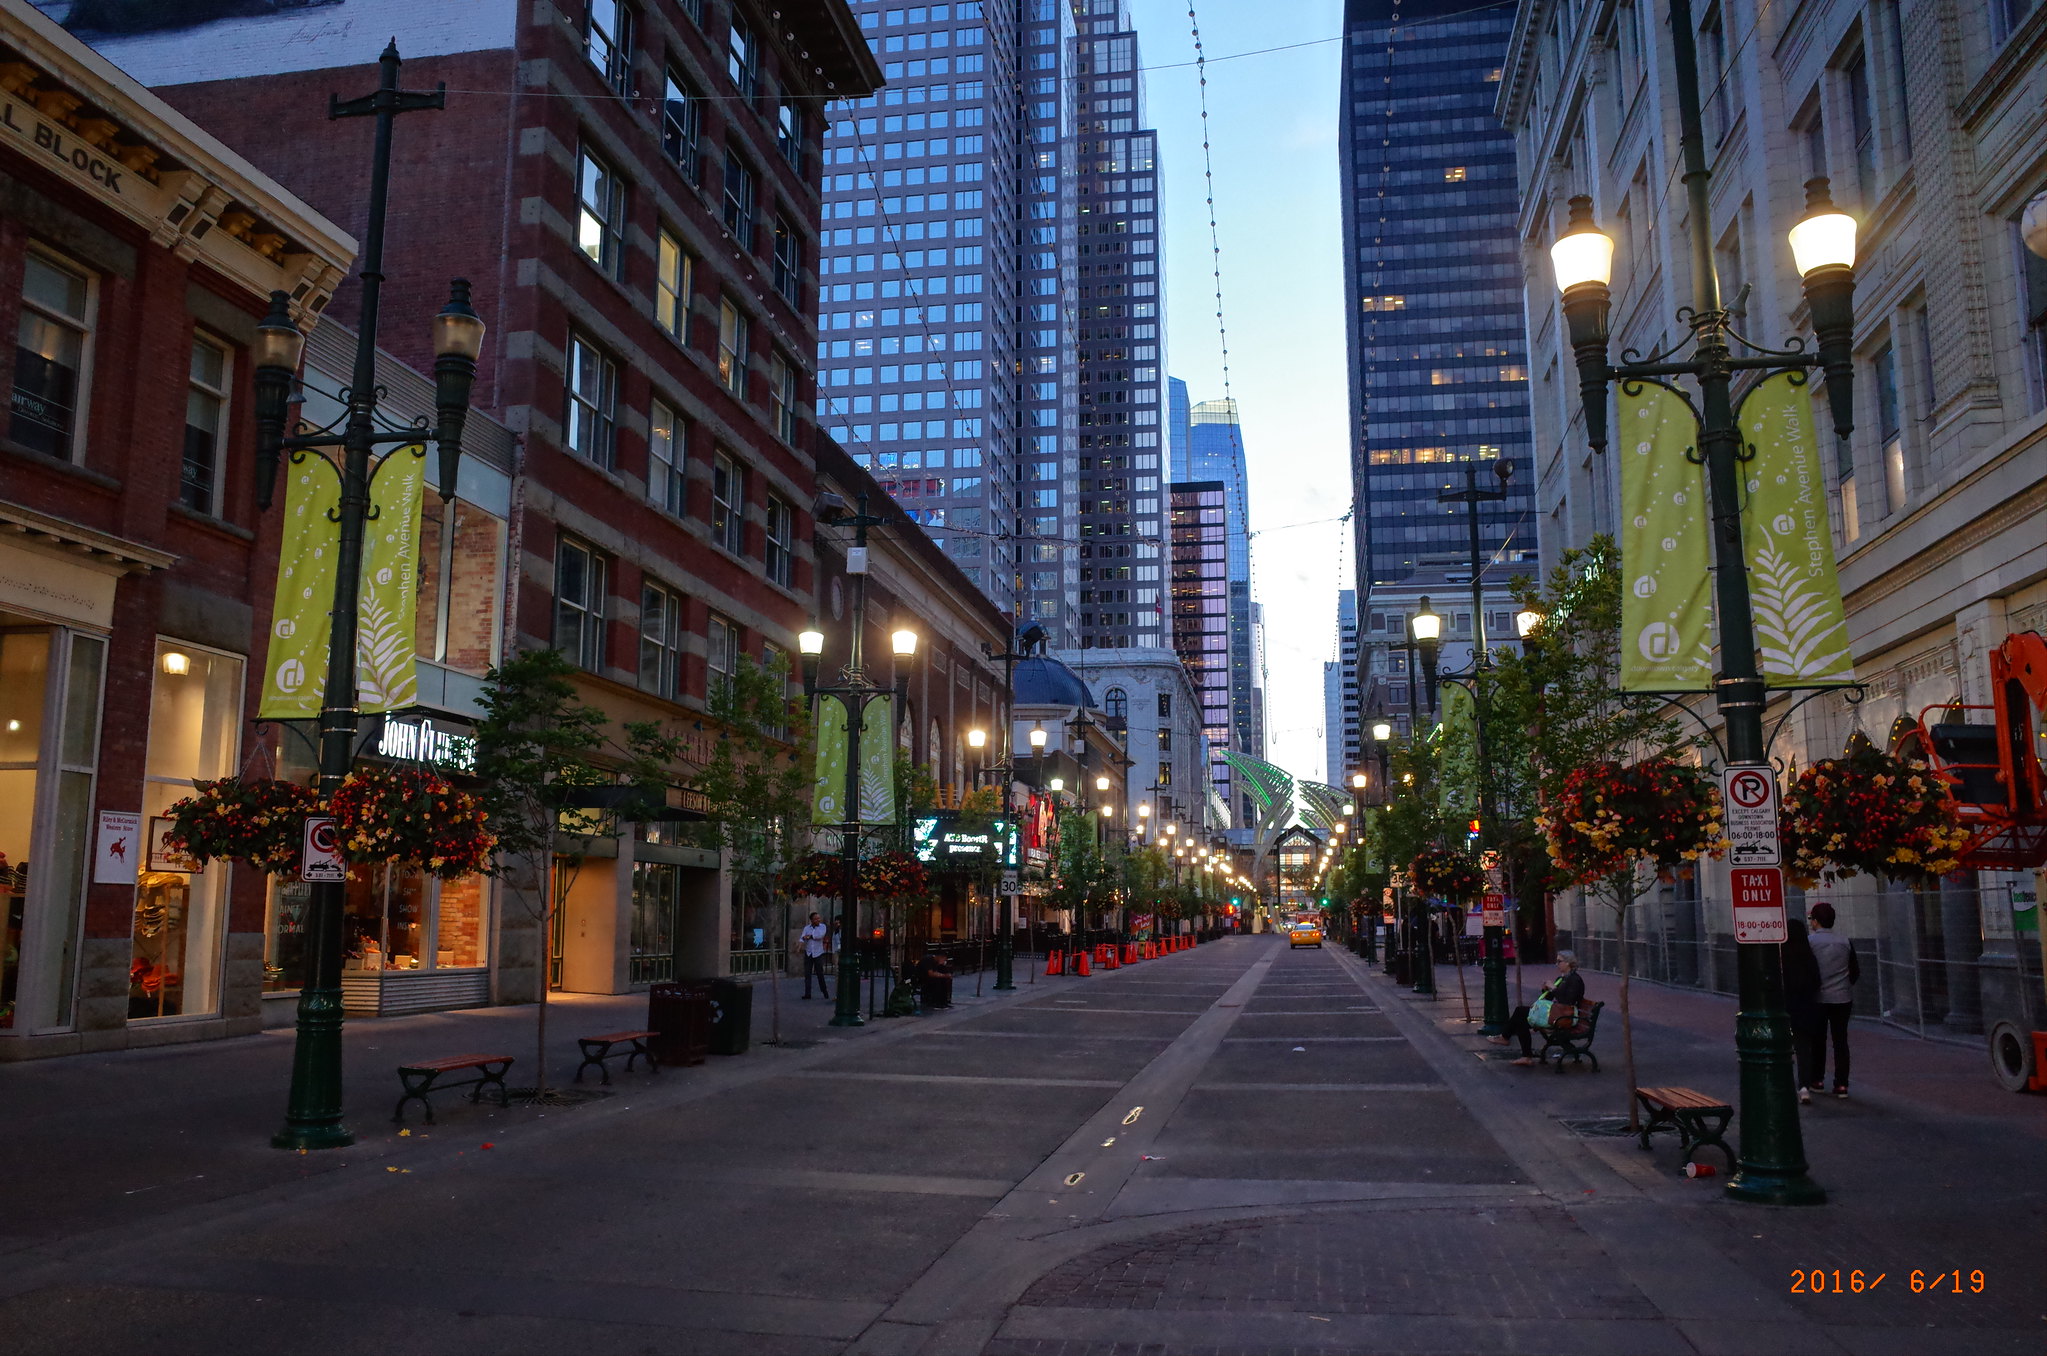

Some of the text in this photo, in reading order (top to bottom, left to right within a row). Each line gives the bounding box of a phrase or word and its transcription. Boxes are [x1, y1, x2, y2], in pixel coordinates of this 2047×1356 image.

[35, 121, 121, 193] BLOCK
[402, 473, 416, 506] Walk
[1782, 404, 1824, 578] Stephen Avenue Walk
[397, 506, 412, 559] Avenue
[378, 710, 418, 761] JOHN
[1002, 881, 1016, 892] 30
[1741, 874, 1769, 887] TAXI
[1742, 889, 1772, 902] ONLY
